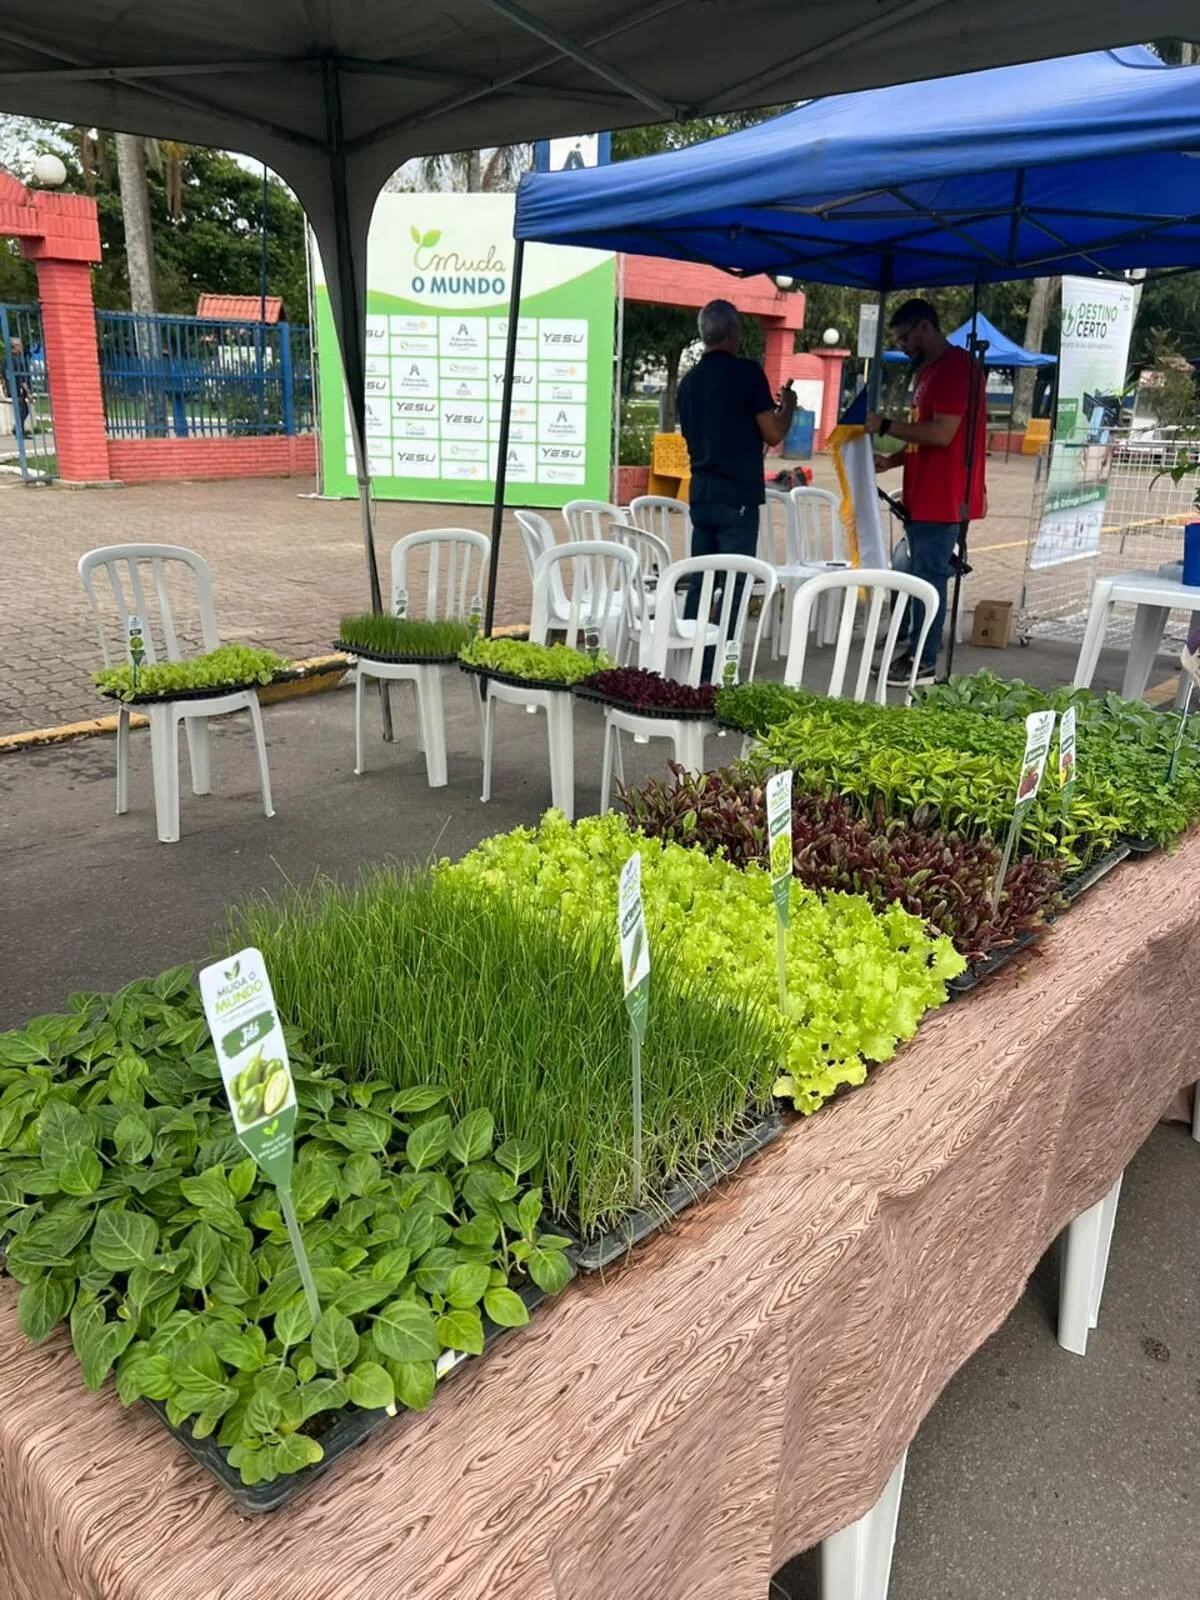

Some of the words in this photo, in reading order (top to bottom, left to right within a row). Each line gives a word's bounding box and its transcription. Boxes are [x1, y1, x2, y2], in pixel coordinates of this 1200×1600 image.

[411, 276, 425, 293] O
[430, 276, 505, 294] MUNDO
[1078, 302, 1118, 323] DESTINO
[366, 329, 385, 339] SU
[1076, 321, 1107, 339] CERTO
[542, 332, 584, 343] YESU
[493, 374, 533, 385] YSU
[366, 381, 386, 390] SU
[396, 402, 435, 412] YESU
[445, 413, 484, 424] YESU
[397, 452, 436, 463] YESU
[542, 448, 582, 458] YESU
[217, 976, 248, 997] MUDA
[248, 971, 257, 981] O
[215, 980, 263, 1014] MUNDO
